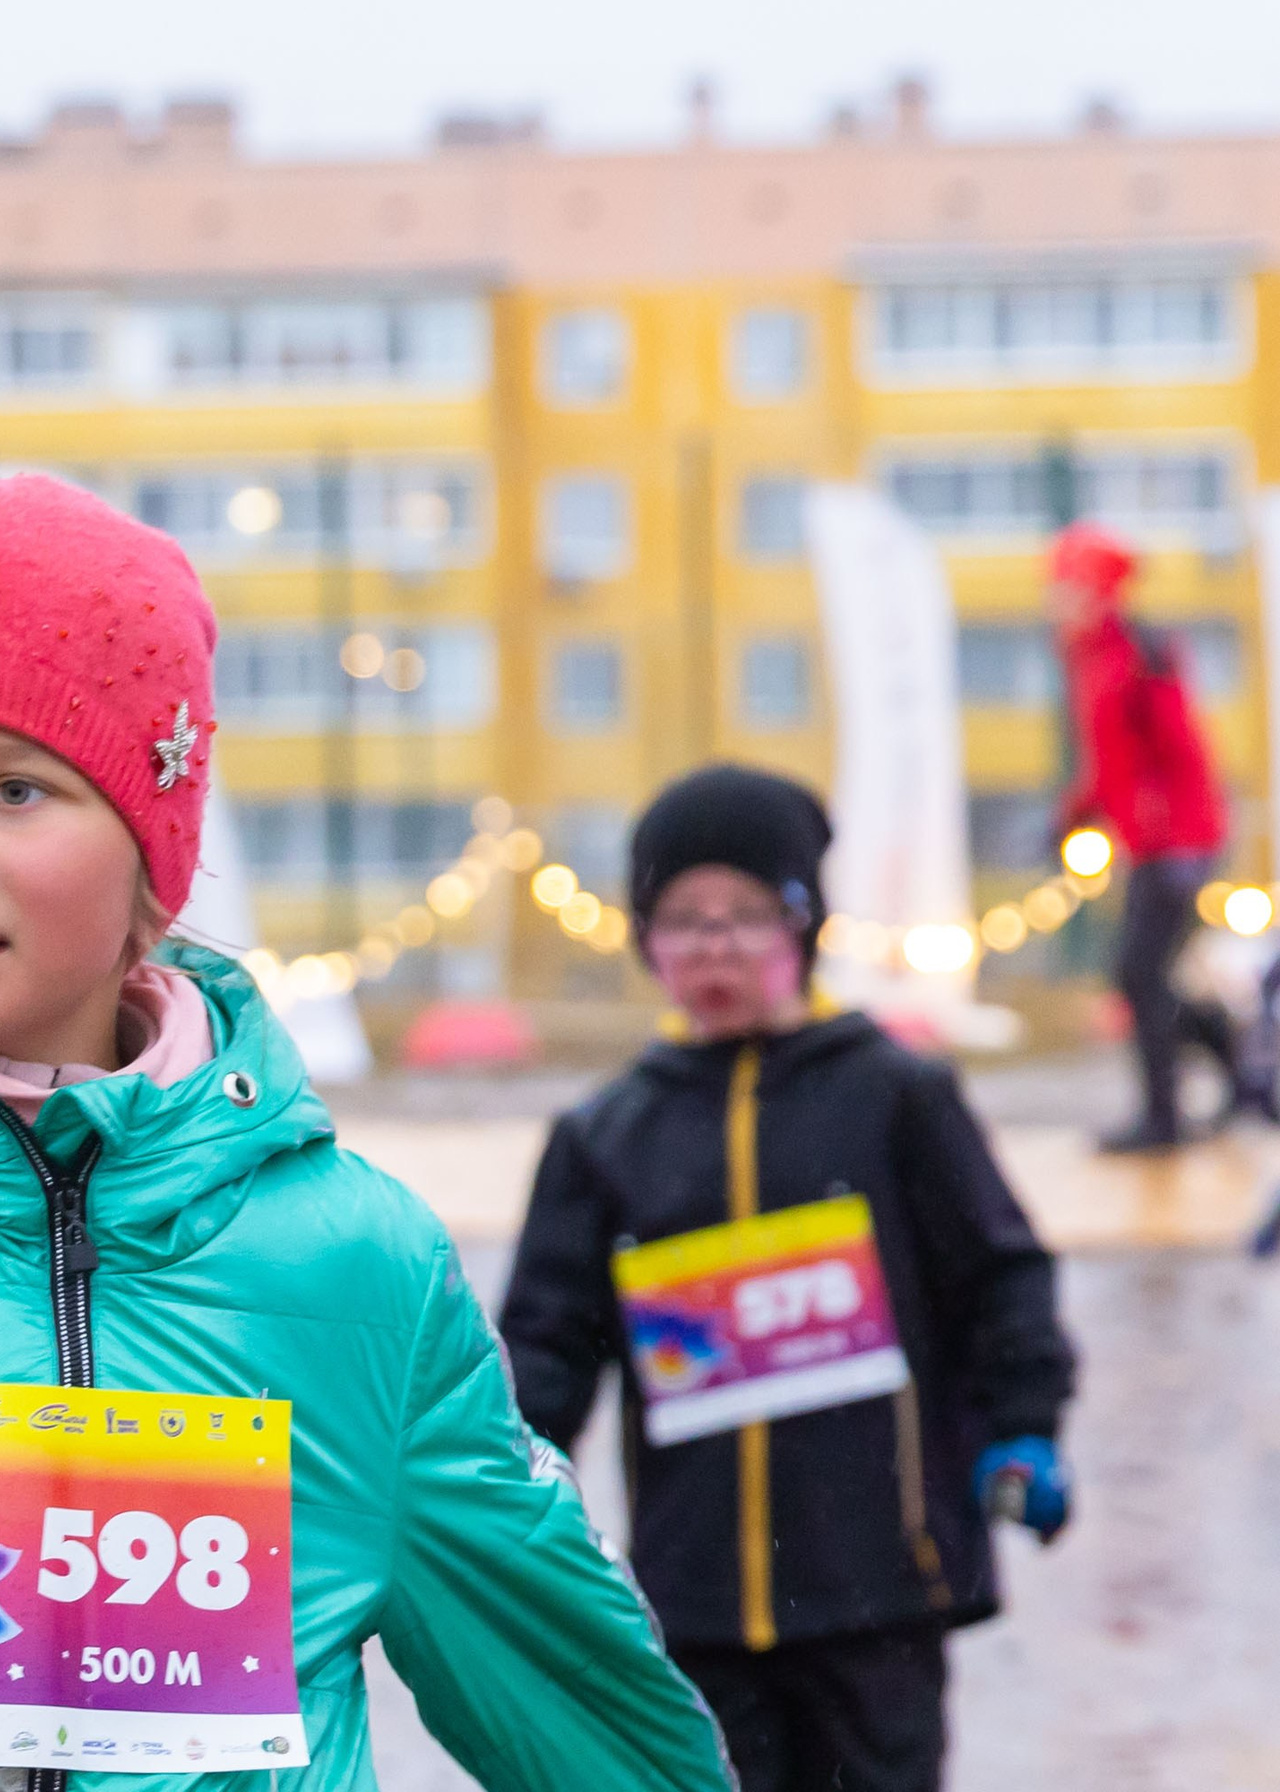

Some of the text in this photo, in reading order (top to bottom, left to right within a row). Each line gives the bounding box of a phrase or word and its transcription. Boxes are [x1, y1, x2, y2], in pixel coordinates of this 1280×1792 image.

[37, 1507, 251, 1611] 598
[79, 1646, 202, 1686] 500 M
